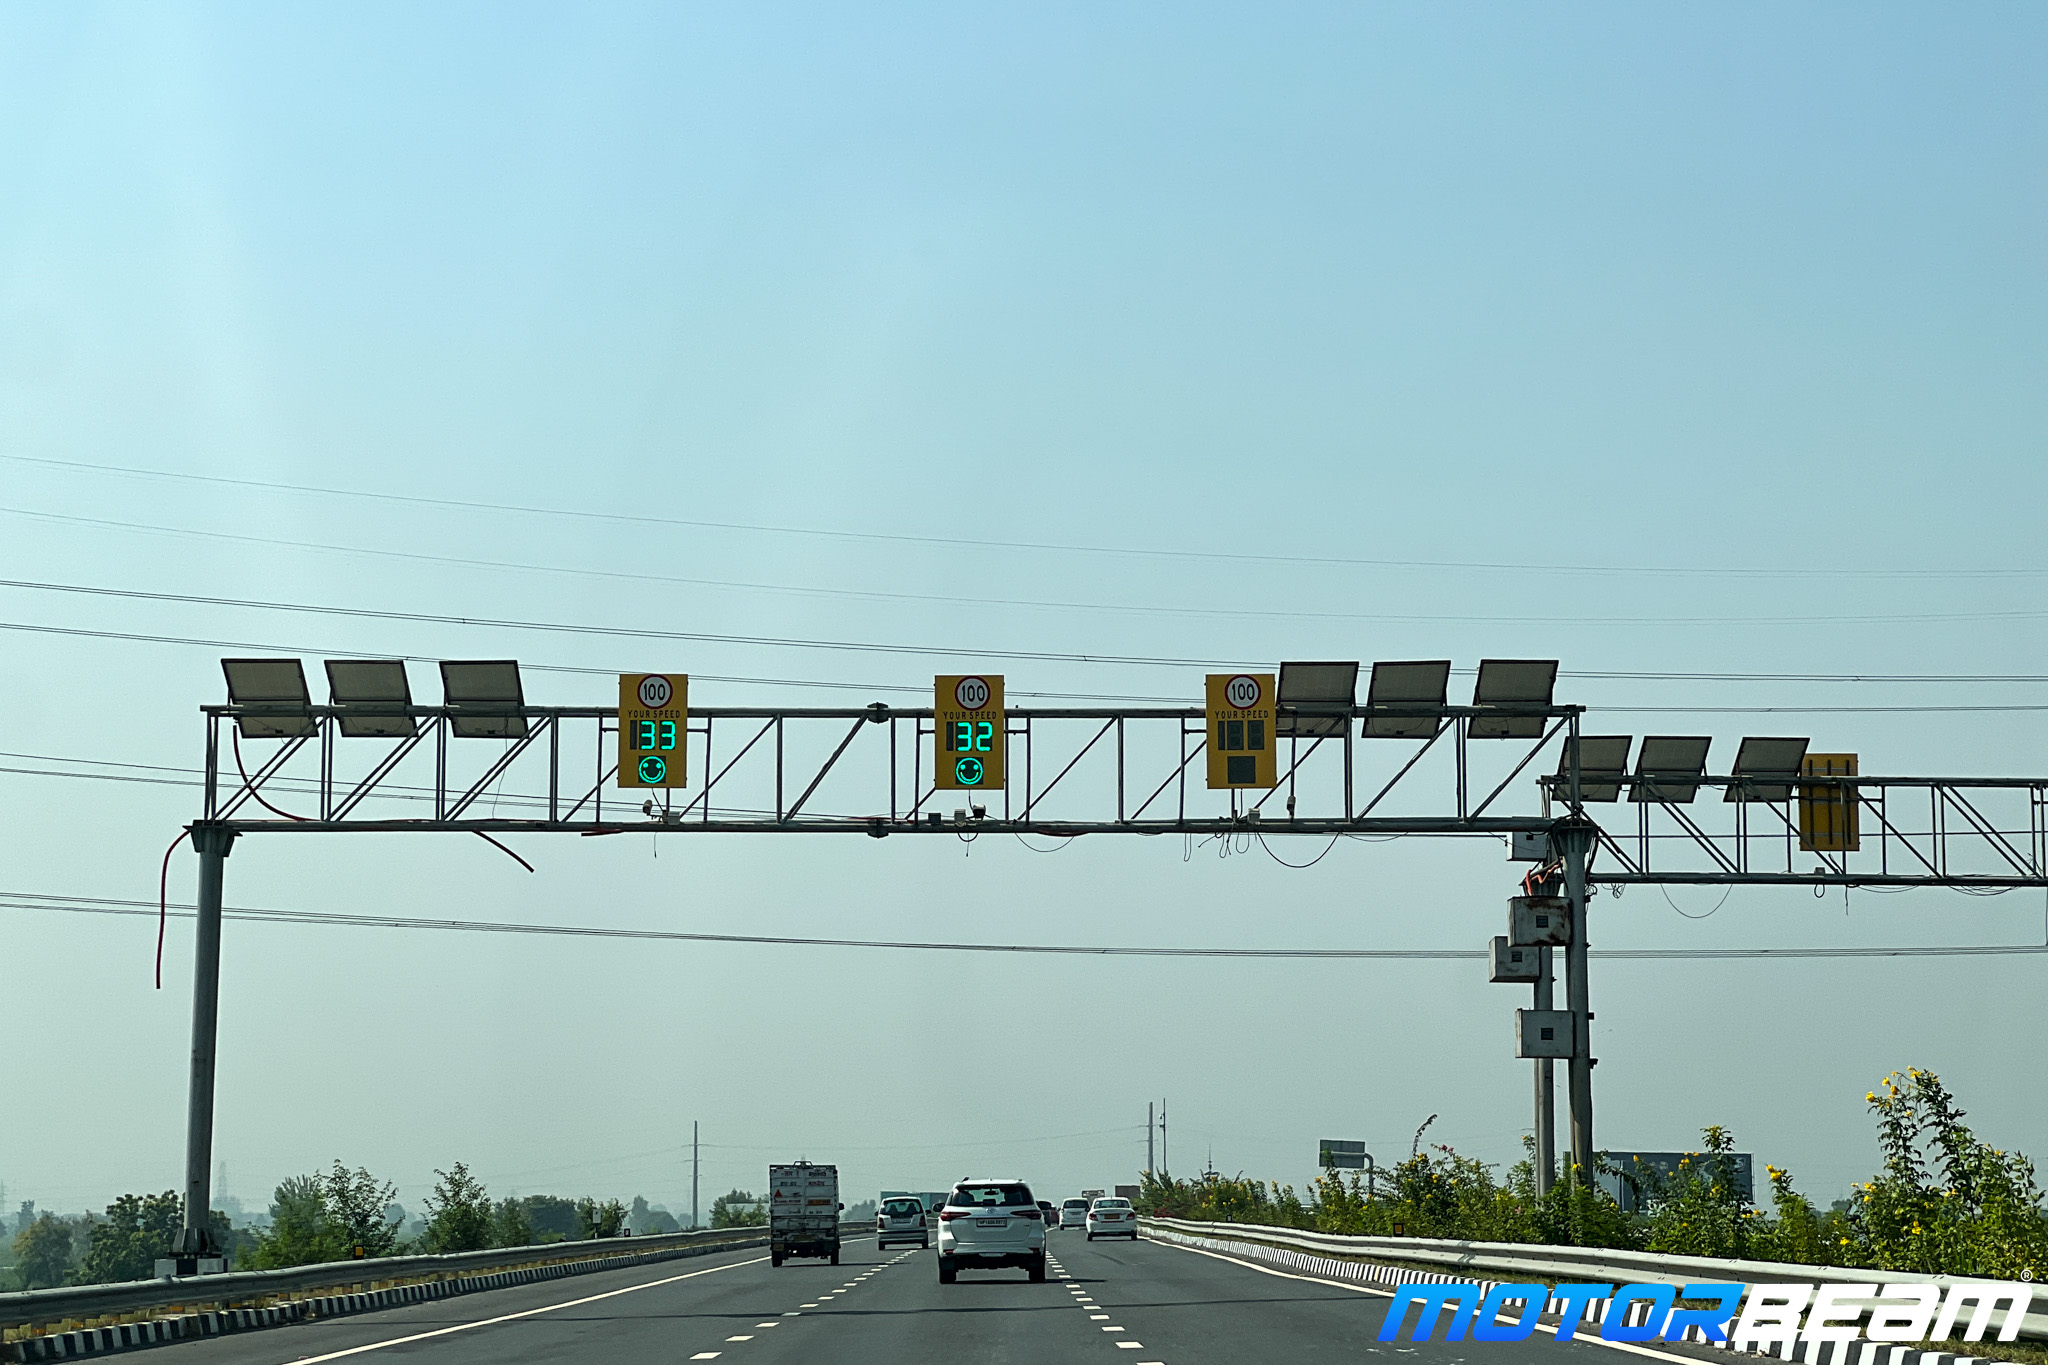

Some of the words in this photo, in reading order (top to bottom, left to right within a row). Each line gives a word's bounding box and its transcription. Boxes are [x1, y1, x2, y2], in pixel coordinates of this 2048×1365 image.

[643, 683, 666, 701] 100
[961, 685, 985, 702] 100
[1232, 683, 1255, 701] 100
[628, 710, 650, 718] YOUR
[653, 710, 680, 718] SPEED
[943, 711, 967, 720] YOUR
[969, 711, 997, 720] SPEED
[1215, 710, 1238, 719] YOUR
[1241, 710, 1269, 719] SPEED
[641, 721, 675, 750] 33
[957, 722, 993, 751] 32
